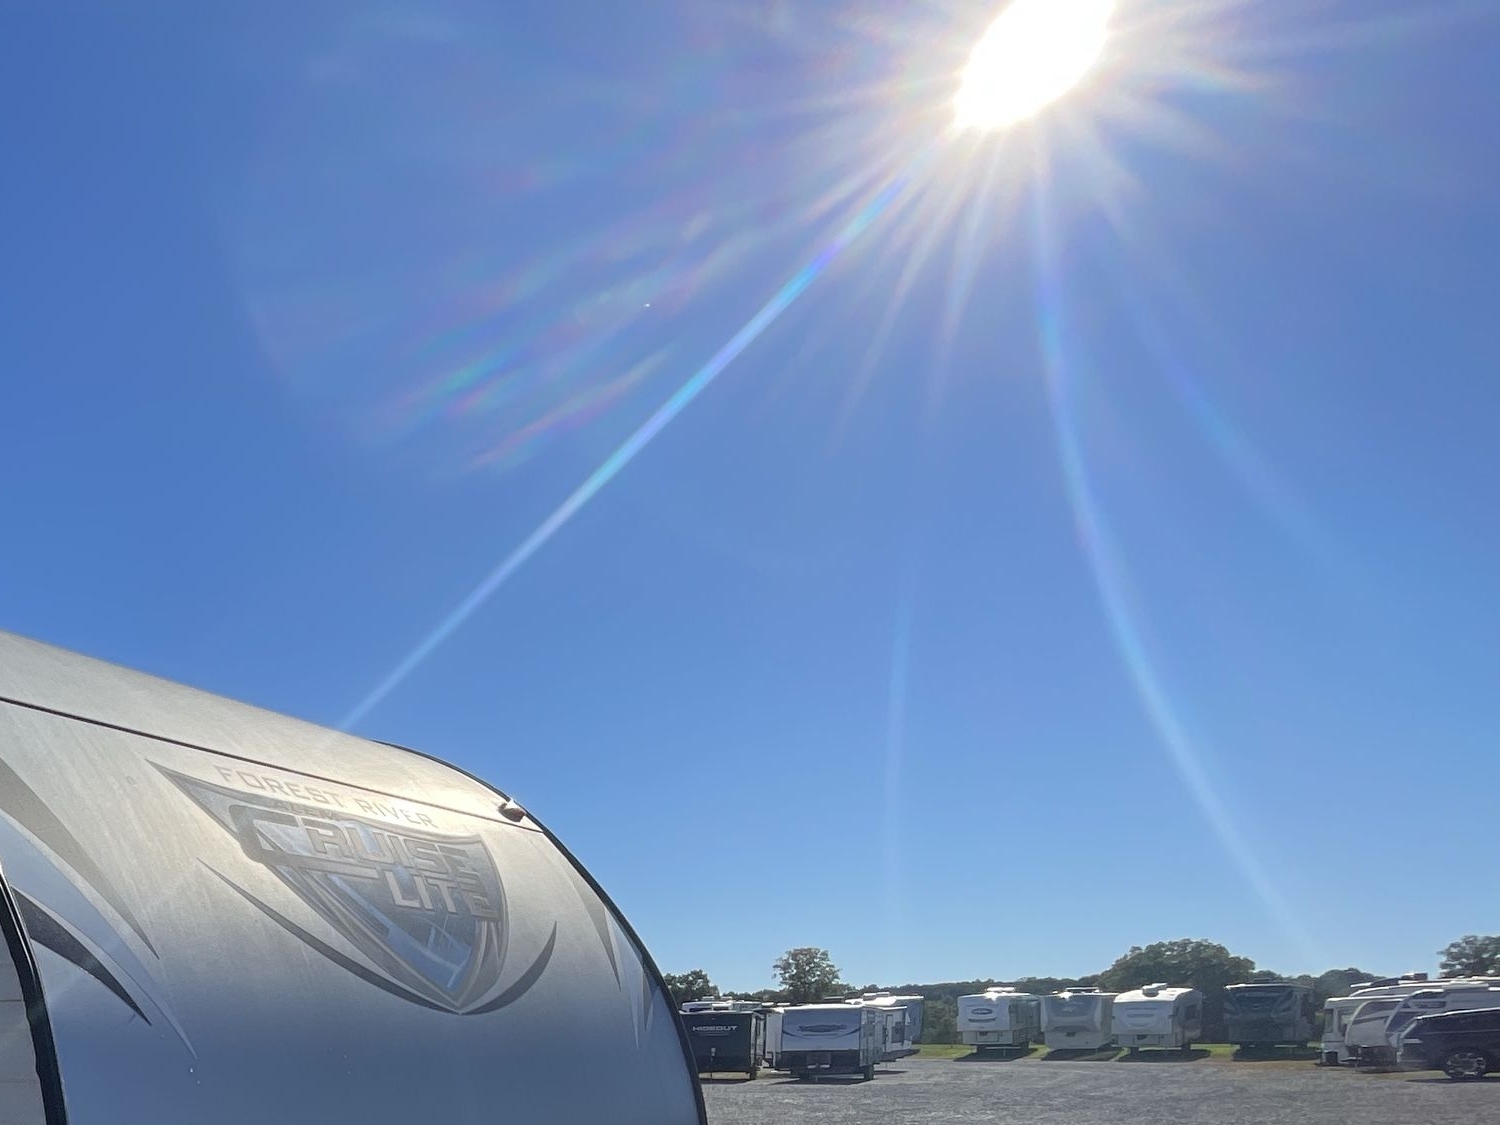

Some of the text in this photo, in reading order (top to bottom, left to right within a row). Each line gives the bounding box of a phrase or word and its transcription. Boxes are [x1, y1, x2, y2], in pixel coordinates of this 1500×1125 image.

[213, 765, 440, 830] FOREST RIVER
[229, 804, 482, 886] CRUISE
[383, 868, 500, 919] LITE
